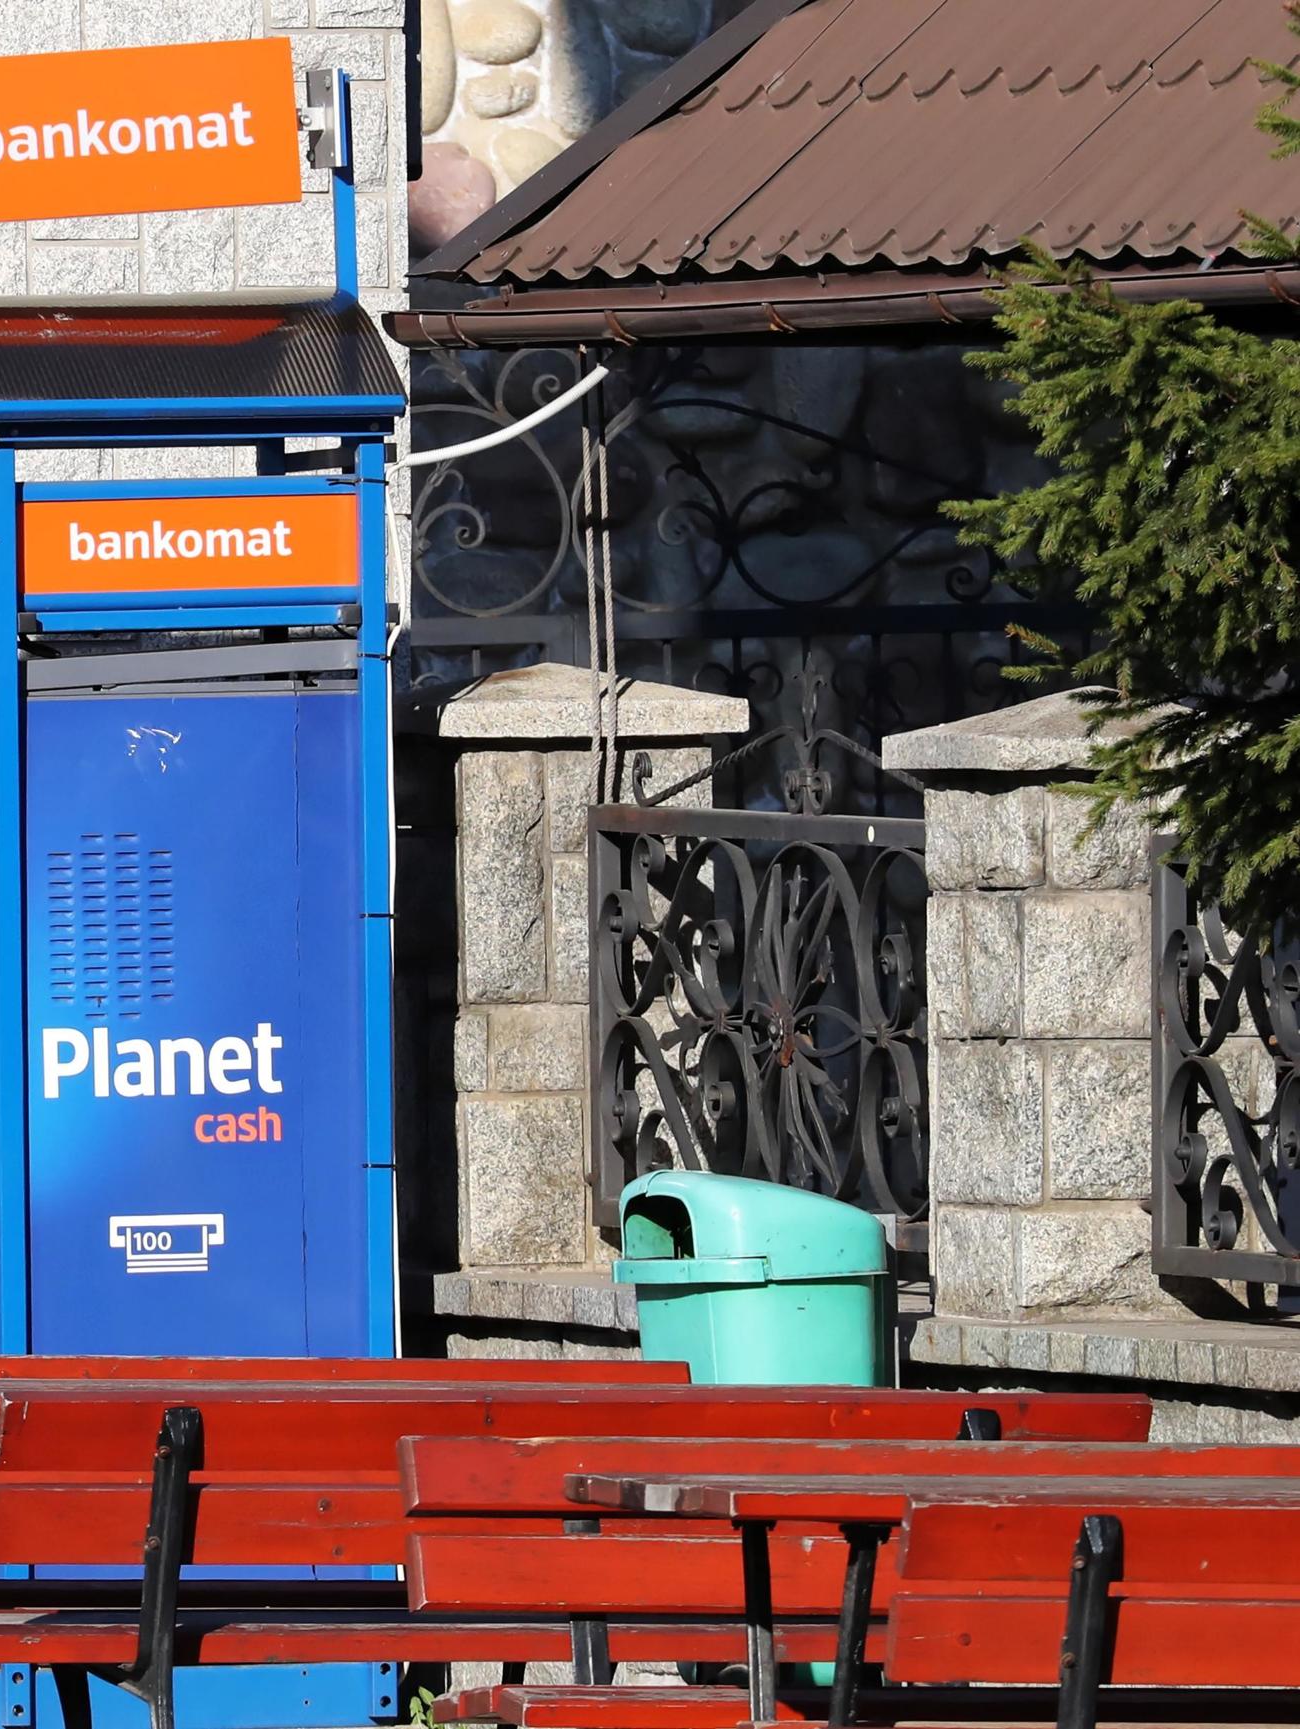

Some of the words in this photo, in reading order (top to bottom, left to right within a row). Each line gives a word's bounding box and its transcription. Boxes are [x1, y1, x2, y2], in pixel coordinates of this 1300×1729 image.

[69, 519, 293, 562] bankomat
[42, 1022, 283, 1099] Planet
[194, 1106, 282, 1143] cash
[132, 1231, 172, 1252] 100
